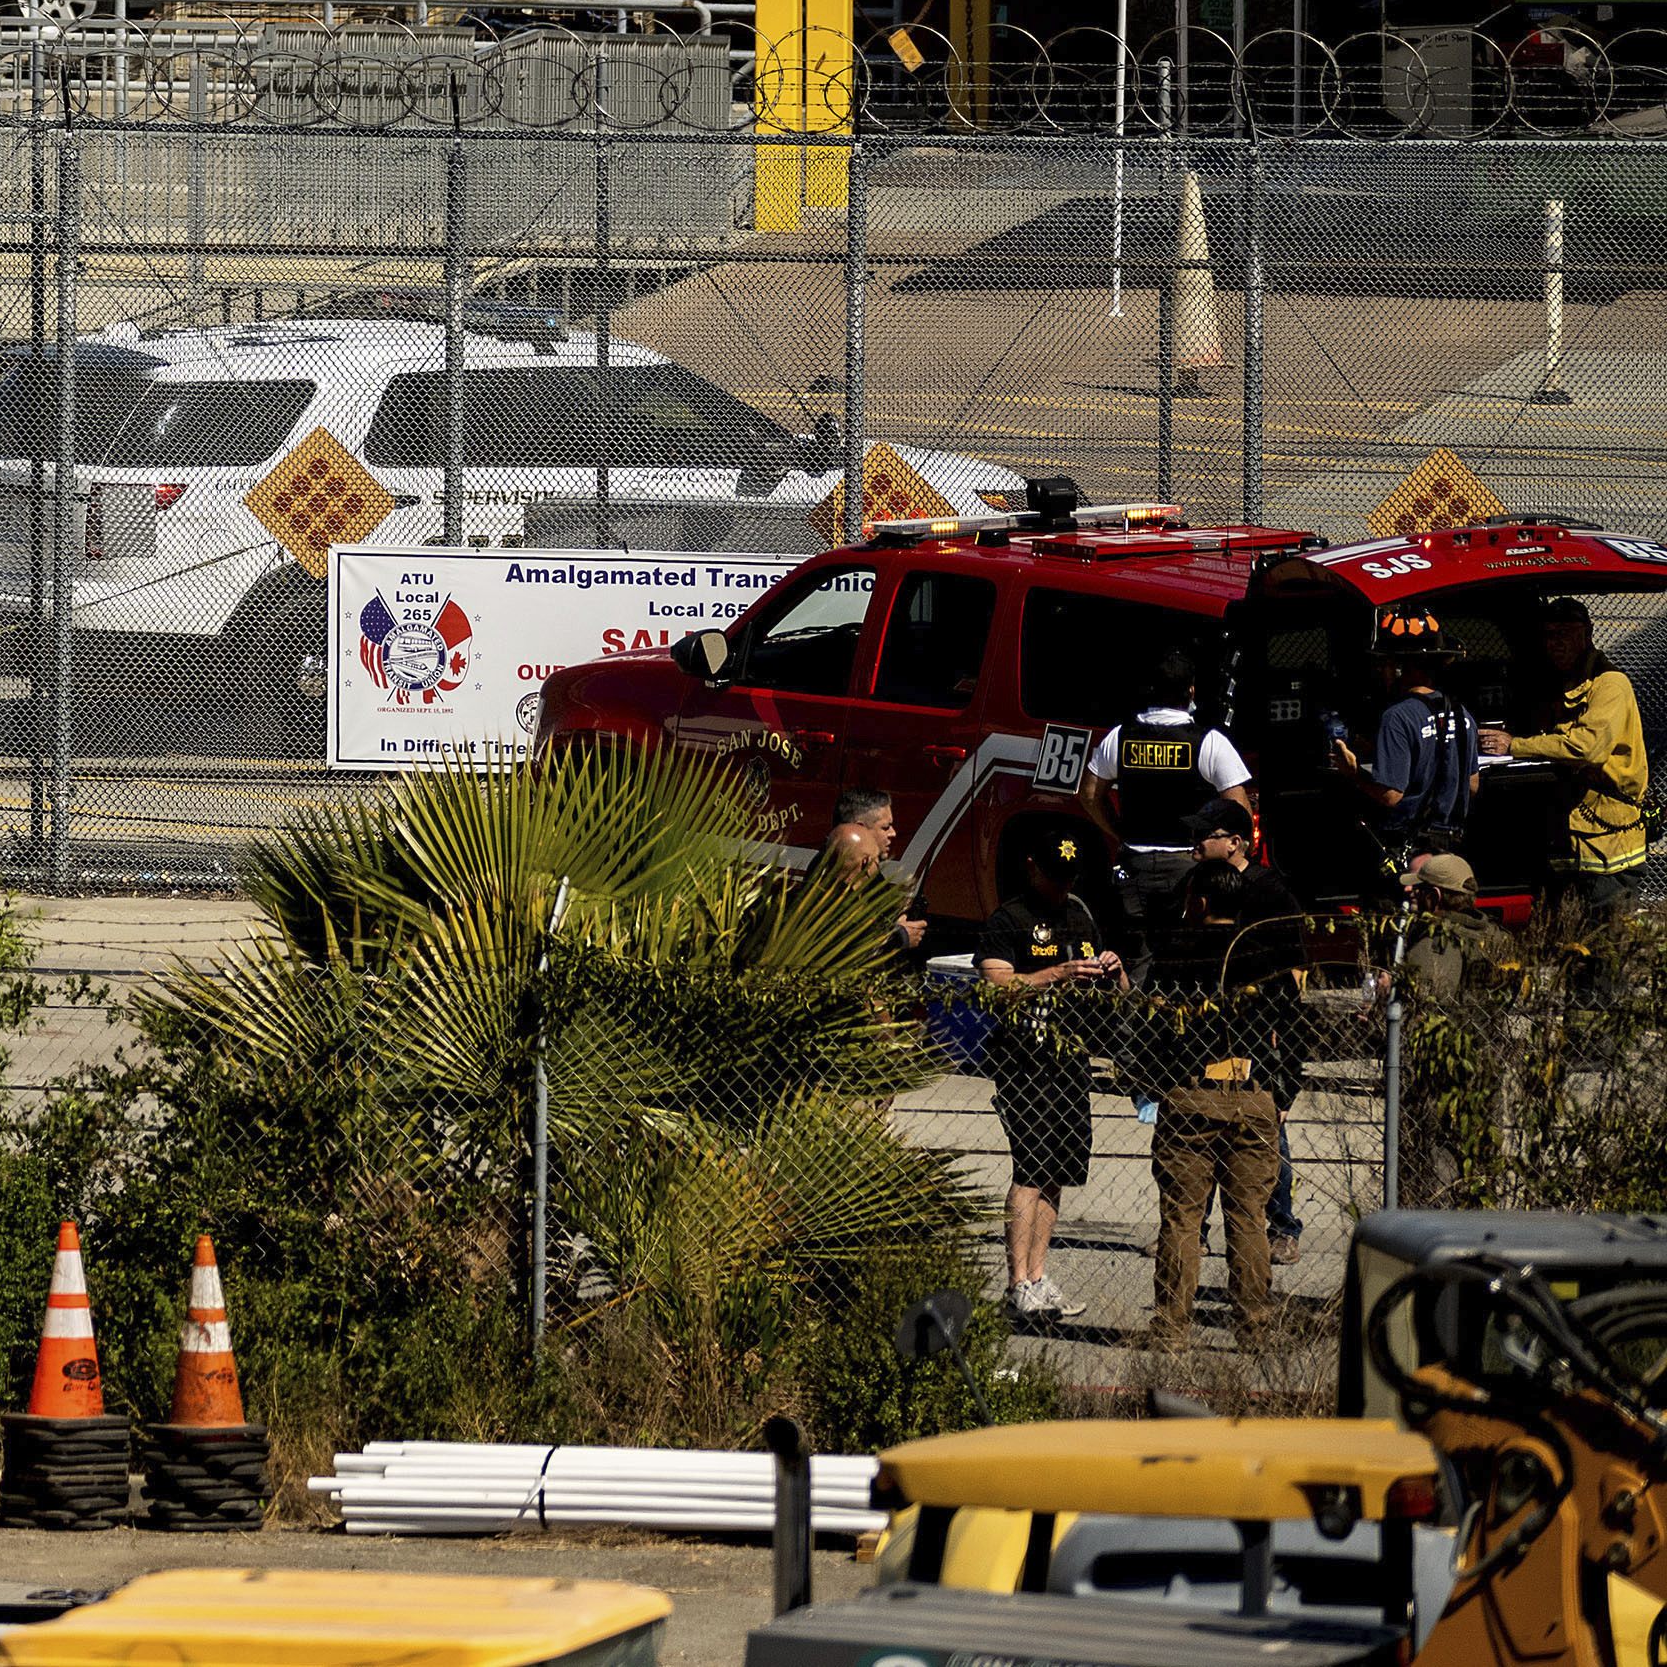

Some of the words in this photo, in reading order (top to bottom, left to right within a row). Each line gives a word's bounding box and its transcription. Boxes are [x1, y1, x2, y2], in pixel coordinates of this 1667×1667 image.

[1604, 538, 1667, 560] B5
[505, 563, 697, 590] Amalgamated
[706, 567, 795, 590] Trans
[1361, 553, 1432, 579] SJS
[400, 573, 434, 586] ATU
[395, 590, 439, 603] Local
[402, 608, 432, 621] 265
[648, 600, 705, 619] Local
[711, 602, 749, 619] 265
[385, 624, 444, 651] AMALGAMATED
[382, 659, 411, 690] TRANSIT
[421, 664, 444, 688] UNION
[380, 738, 398, 752] In
[403, 739, 477, 754] Difficult
[716, 728, 752, 757] SAN
[757, 729, 803, 770] JOSE
[1037, 732, 1085, 784] B5
[1130, 743, 1183, 767] SHERIFF
[757, 802, 804, 832] DEPT.
[1031, 944, 1058, 957] SHERIFF
